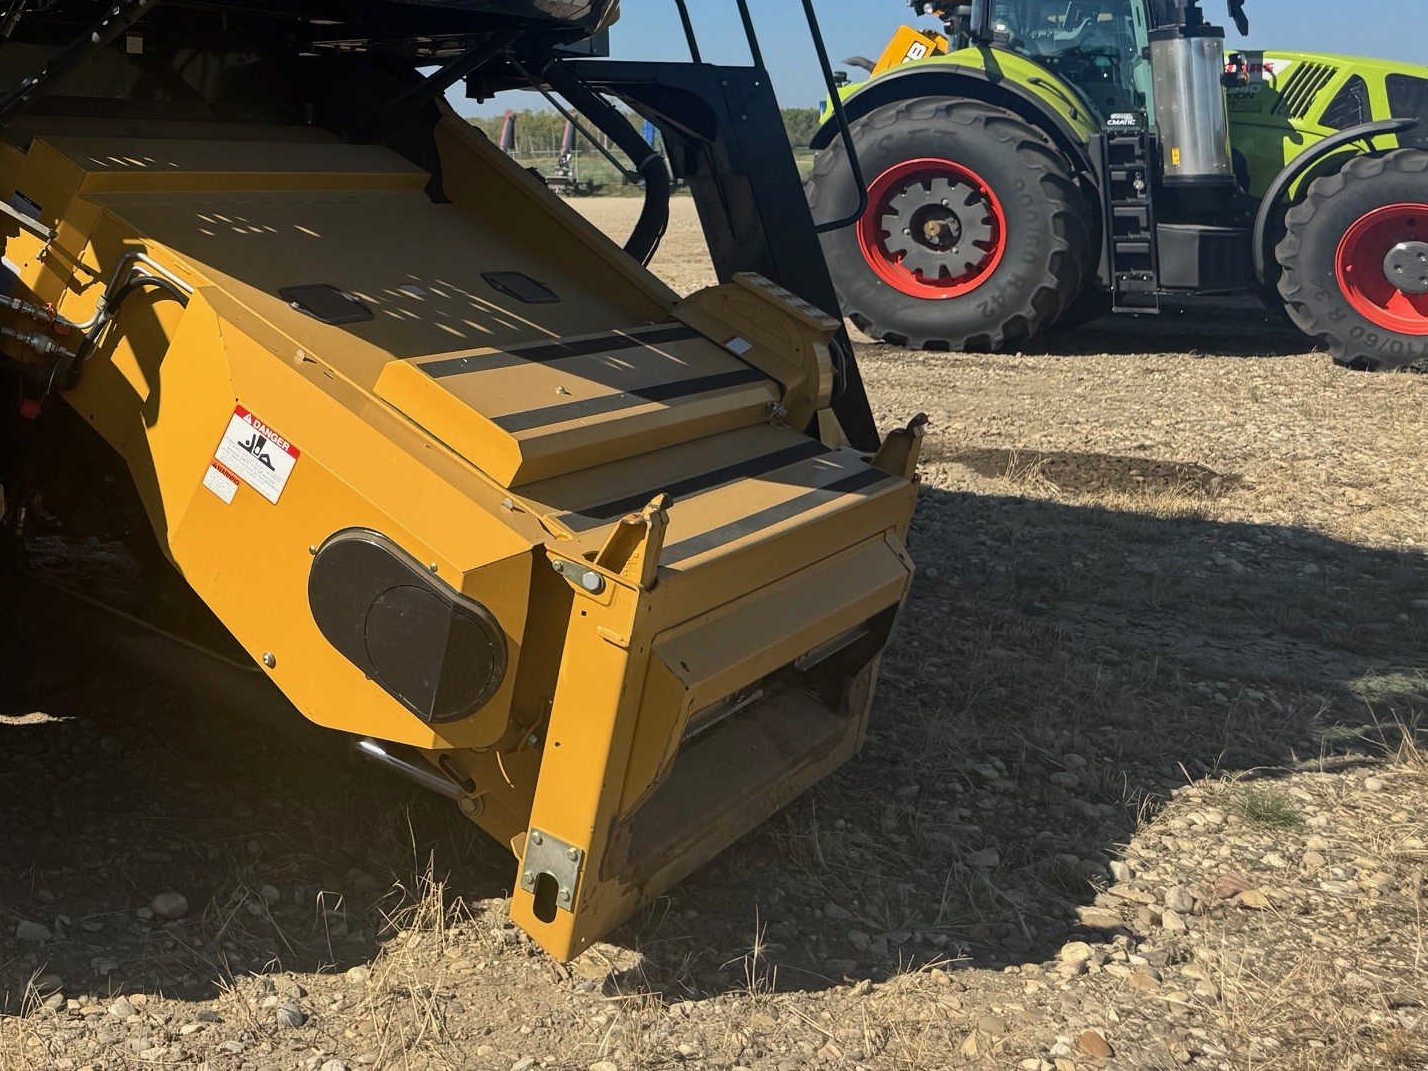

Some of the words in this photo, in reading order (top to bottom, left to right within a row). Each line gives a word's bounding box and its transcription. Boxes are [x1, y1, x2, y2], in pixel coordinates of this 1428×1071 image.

[1349, 325, 1428, 355] 10/60
[253, 419, 291, 452] DANGER
[217, 466, 240, 486] WARNING
